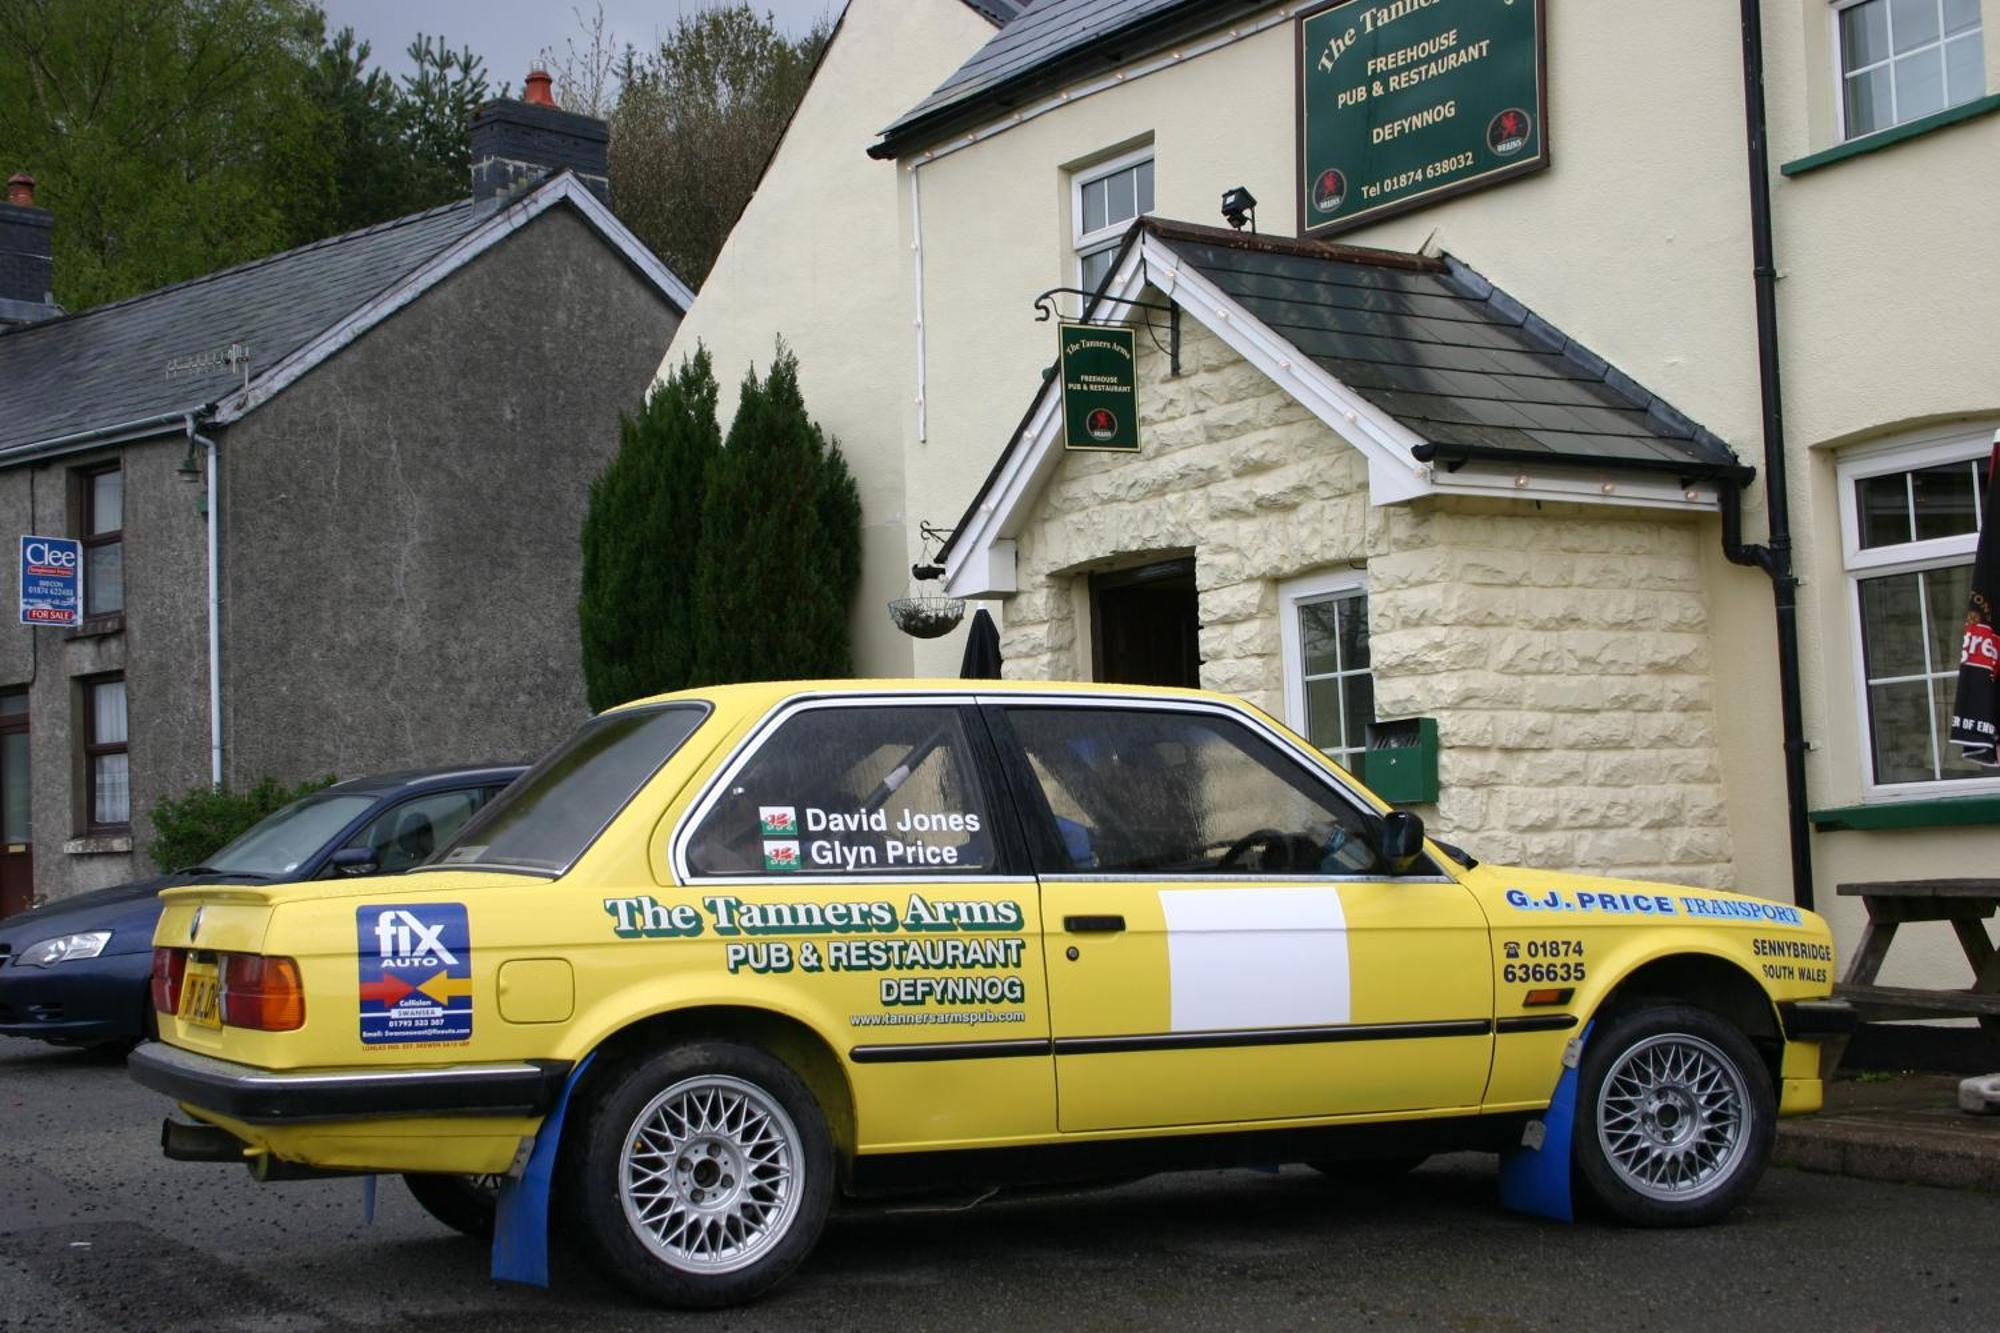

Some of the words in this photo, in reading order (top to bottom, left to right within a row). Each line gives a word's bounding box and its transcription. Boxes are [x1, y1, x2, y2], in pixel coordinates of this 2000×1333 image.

[1318, 27, 1356, 74] The
[1360, 0, 1440, 34] Tann
[1367, 29, 1457, 76] FREEHOUSE
[1338, 86, 1367, 109] PUB
[1372, 81, 1385, 97] &
[1388, 39, 1490, 92] RESTAURANT
[1372, 101, 1456, 144] DEFYNNOG
[1361, 182, 1380, 199] Tel
[1384, 168, 1423, 192] 01874
[1426, 151, 1474, 179] 638032
[1066, 343, 1080, 355] The
[1080, 339, 1111, 349] Tanners
[1068, 383, 1081, 391] PUB
[1089, 384, 1131, 393] RESTAURANT
[1080, 375, 1118, 383] FREEHOUSE
[26, 543, 75, 567] Clee
[32, 610, 48, 619] FOR
[50, 611, 69, 620] SALE
[1962, 718, 1975, 730] OF
[806, 808, 887, 832] David
[897, 808, 980, 832] Jones
[811, 840, 876, 870] Glyn
[886, 840, 958, 864] Price
[603, 896, 704, 939] The
[703, 896, 899, 937] Tanners
[901, 893, 1025, 932] Arms
[1679, 897, 1802, 926] TRANSPORT
[374, 910, 459, 965] fix
[1527, 941, 1584, 957] 01874
[726, 942, 793, 975] PUB
[799, 941, 825, 973] &
[828, 939, 1025, 971] RESTAURANT
[1752, 938, 1832, 961] SENNYBRIDGE
[381, 957, 439, 968] AUTO
[1503, 962, 1586, 983] 636635
[1762, 964, 1795, 980] SOUTH
[1798, 966, 1826, 983] WALES
[880, 976, 1025, 1006] DEFYNNOG
[398, 1009, 436, 1017] SWANSEA
[399, 999, 432, 1007] Collision
[850, 1009, 1025, 1026] www.tannersarmspub.com
